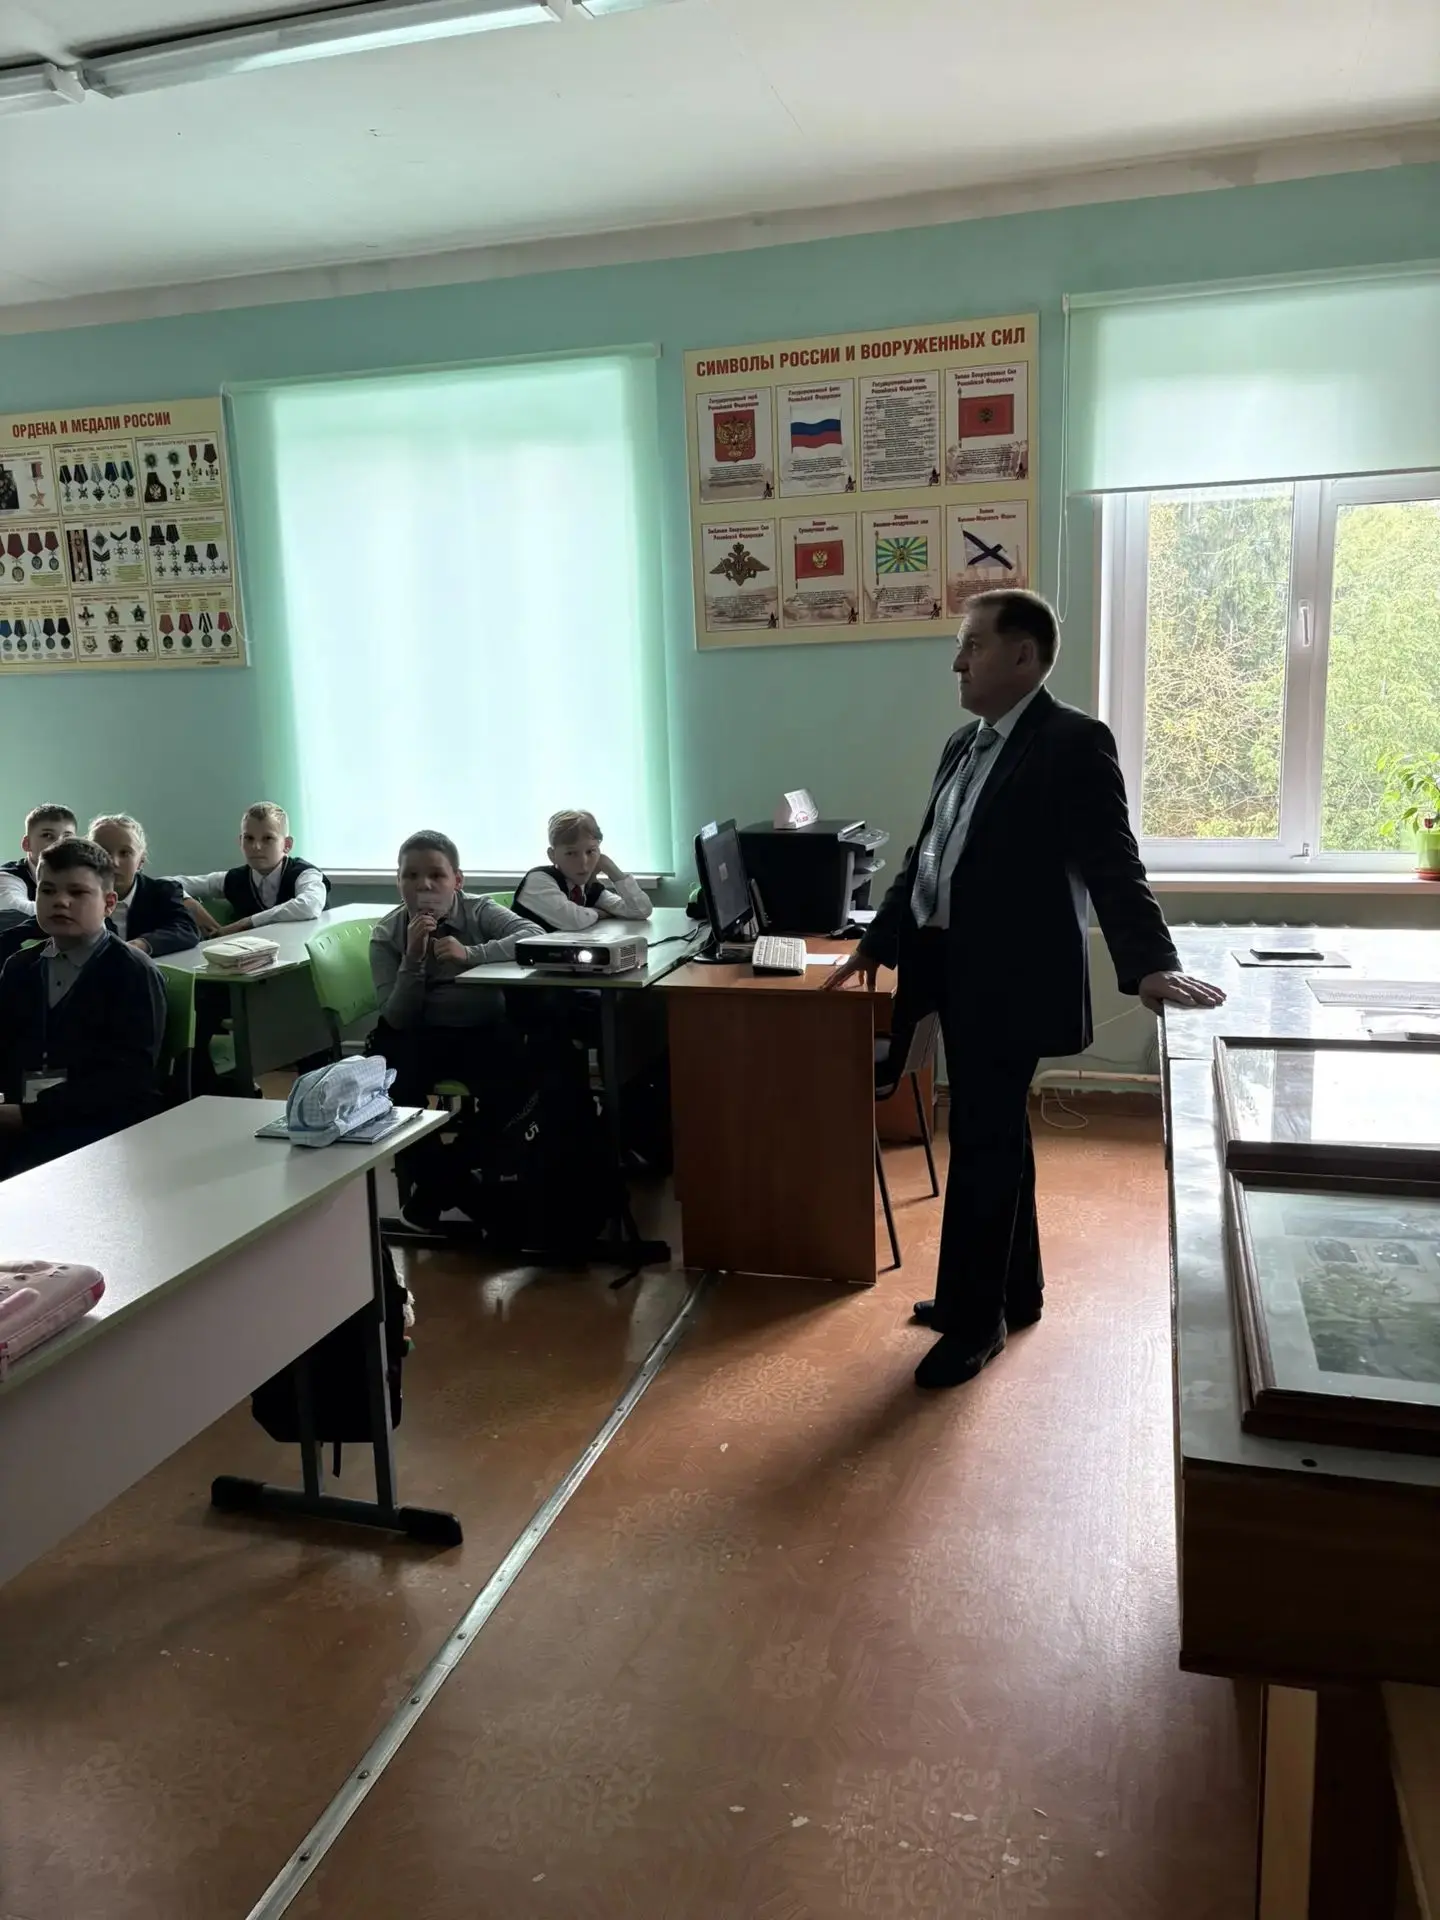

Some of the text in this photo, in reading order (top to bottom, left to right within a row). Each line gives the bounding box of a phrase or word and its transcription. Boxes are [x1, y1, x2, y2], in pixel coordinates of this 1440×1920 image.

[696, 327, 1025, 377] СИМВОЛЫ РОССИИ И ВООРУЖЕННЫХ СИЛ
[12, 411, 171, 439] ОРДЕНА И МЕДАЛИ РОССИИ
